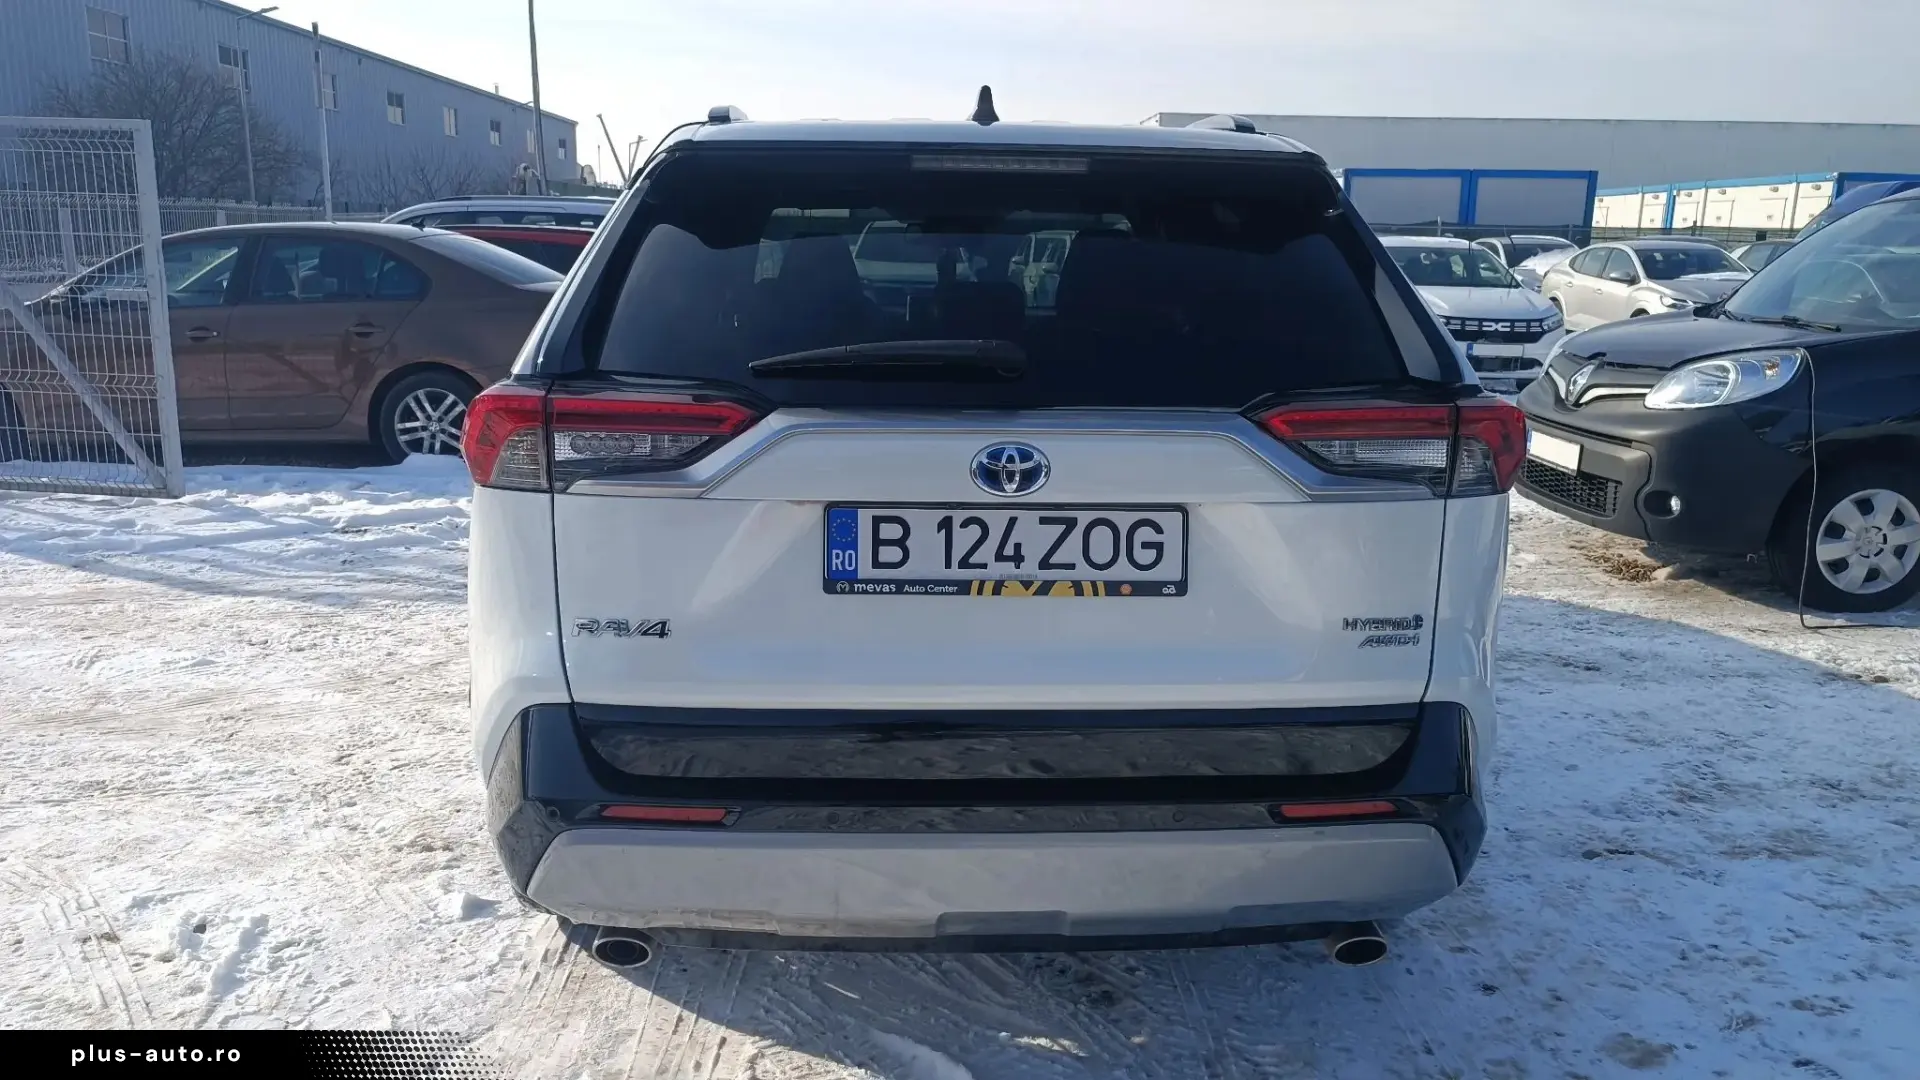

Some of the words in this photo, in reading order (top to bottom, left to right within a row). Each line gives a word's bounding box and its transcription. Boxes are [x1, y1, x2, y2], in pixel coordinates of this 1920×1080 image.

[871, 515, 911, 570] B
[937, 515, 1025, 570] 124
[1037, 516, 1165, 571] ZOG
[832, 549, 856, 570] RO
[853, 583, 896, 592] mevas
[903, 584, 926, 593] Auto
[927, 584, 958, 593] Center
[571, 618, 671, 638] RAV4
[1342, 617, 1412, 631] HYBRID
